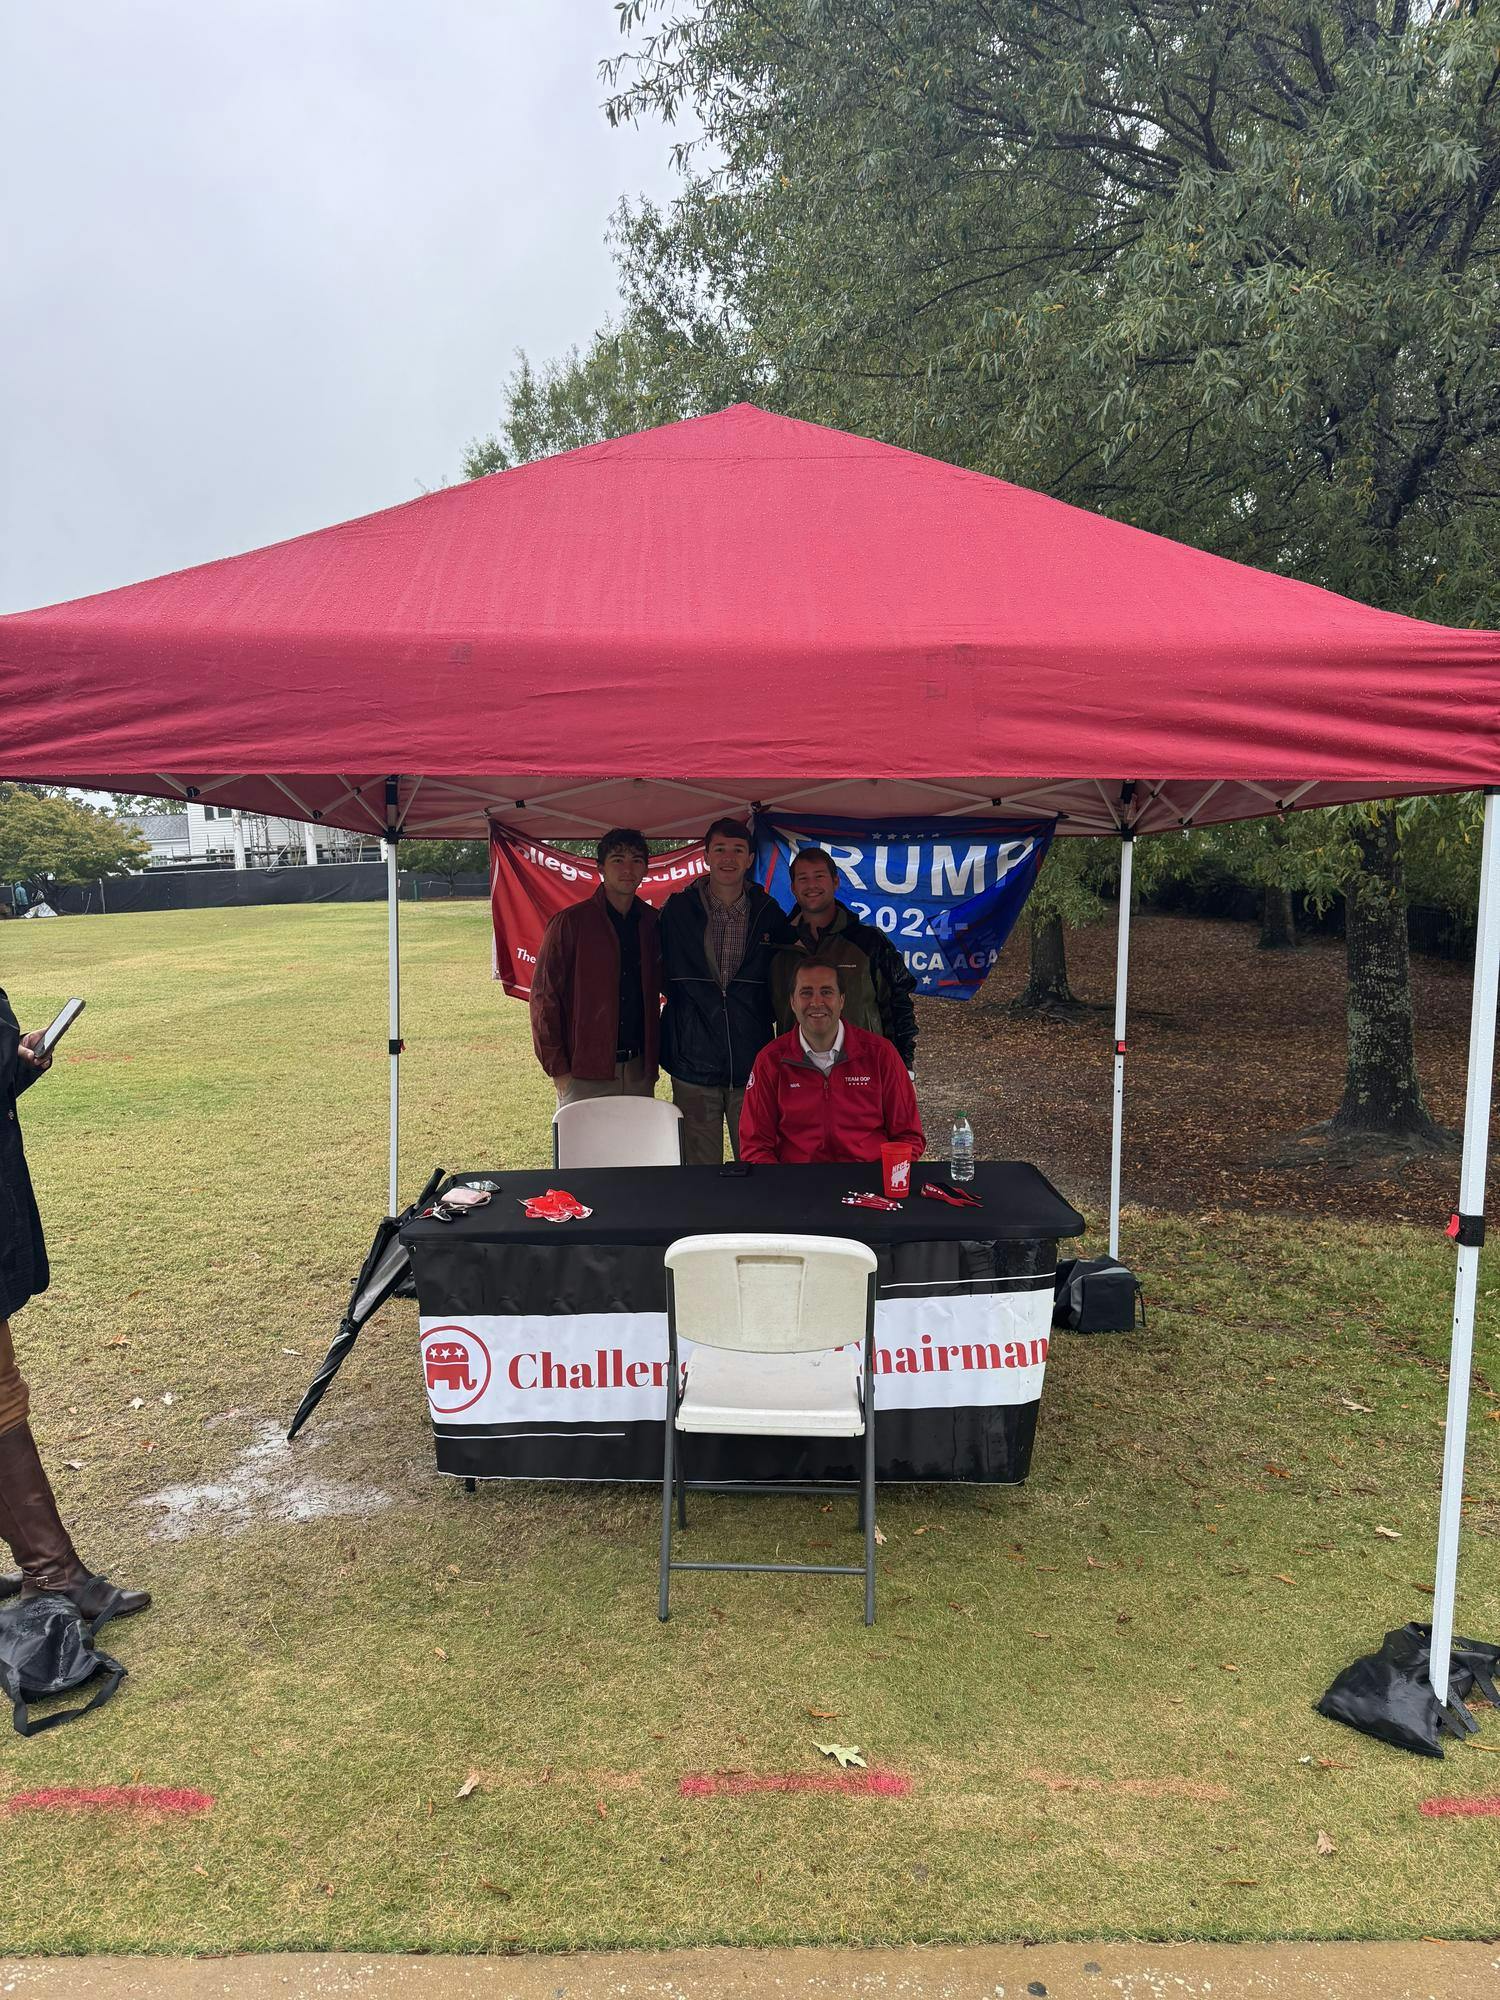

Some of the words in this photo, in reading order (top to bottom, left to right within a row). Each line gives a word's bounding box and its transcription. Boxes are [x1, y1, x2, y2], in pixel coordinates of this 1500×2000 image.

[773, 827, 1036, 896] TRUMP
[516, 947, 537, 964] The
[834, 1334, 1048, 1375] hairman
